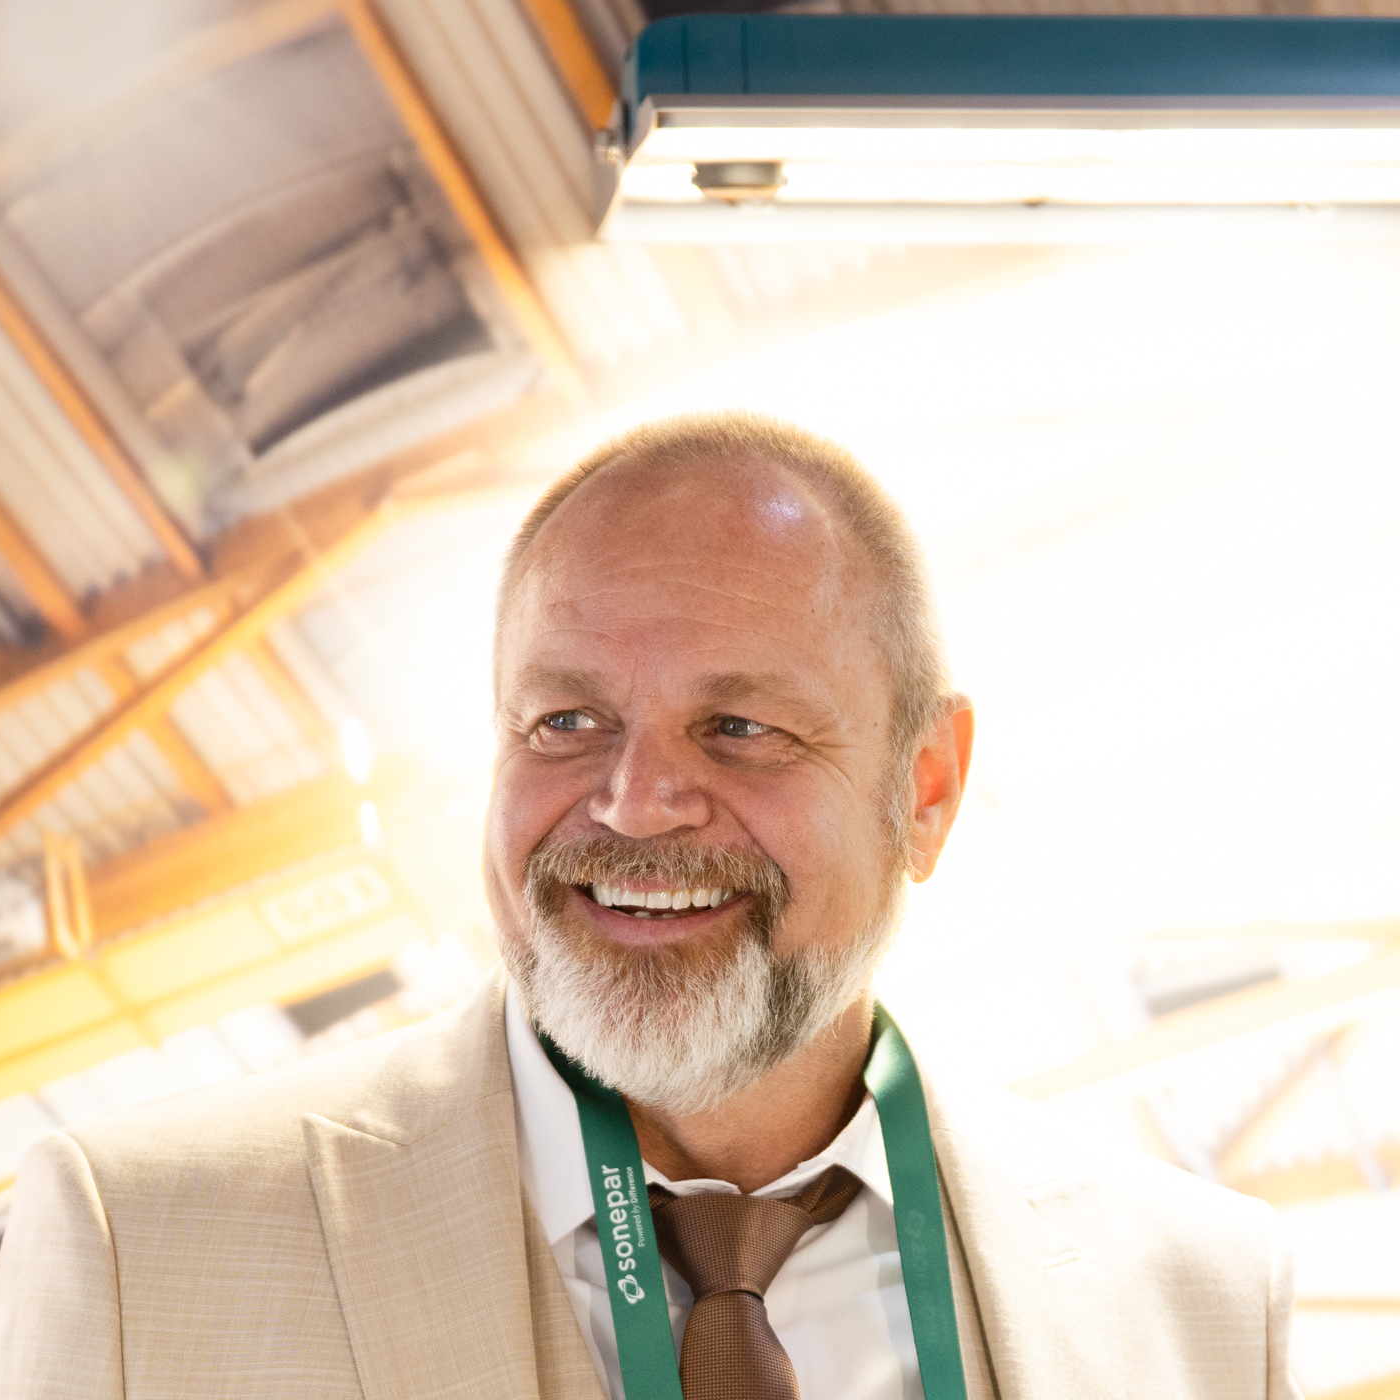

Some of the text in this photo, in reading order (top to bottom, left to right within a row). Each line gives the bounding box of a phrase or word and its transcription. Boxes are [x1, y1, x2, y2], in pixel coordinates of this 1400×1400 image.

[601, 1165, 637, 1272] sonepar
[626, 1166, 646, 1248] Powered by Difference
